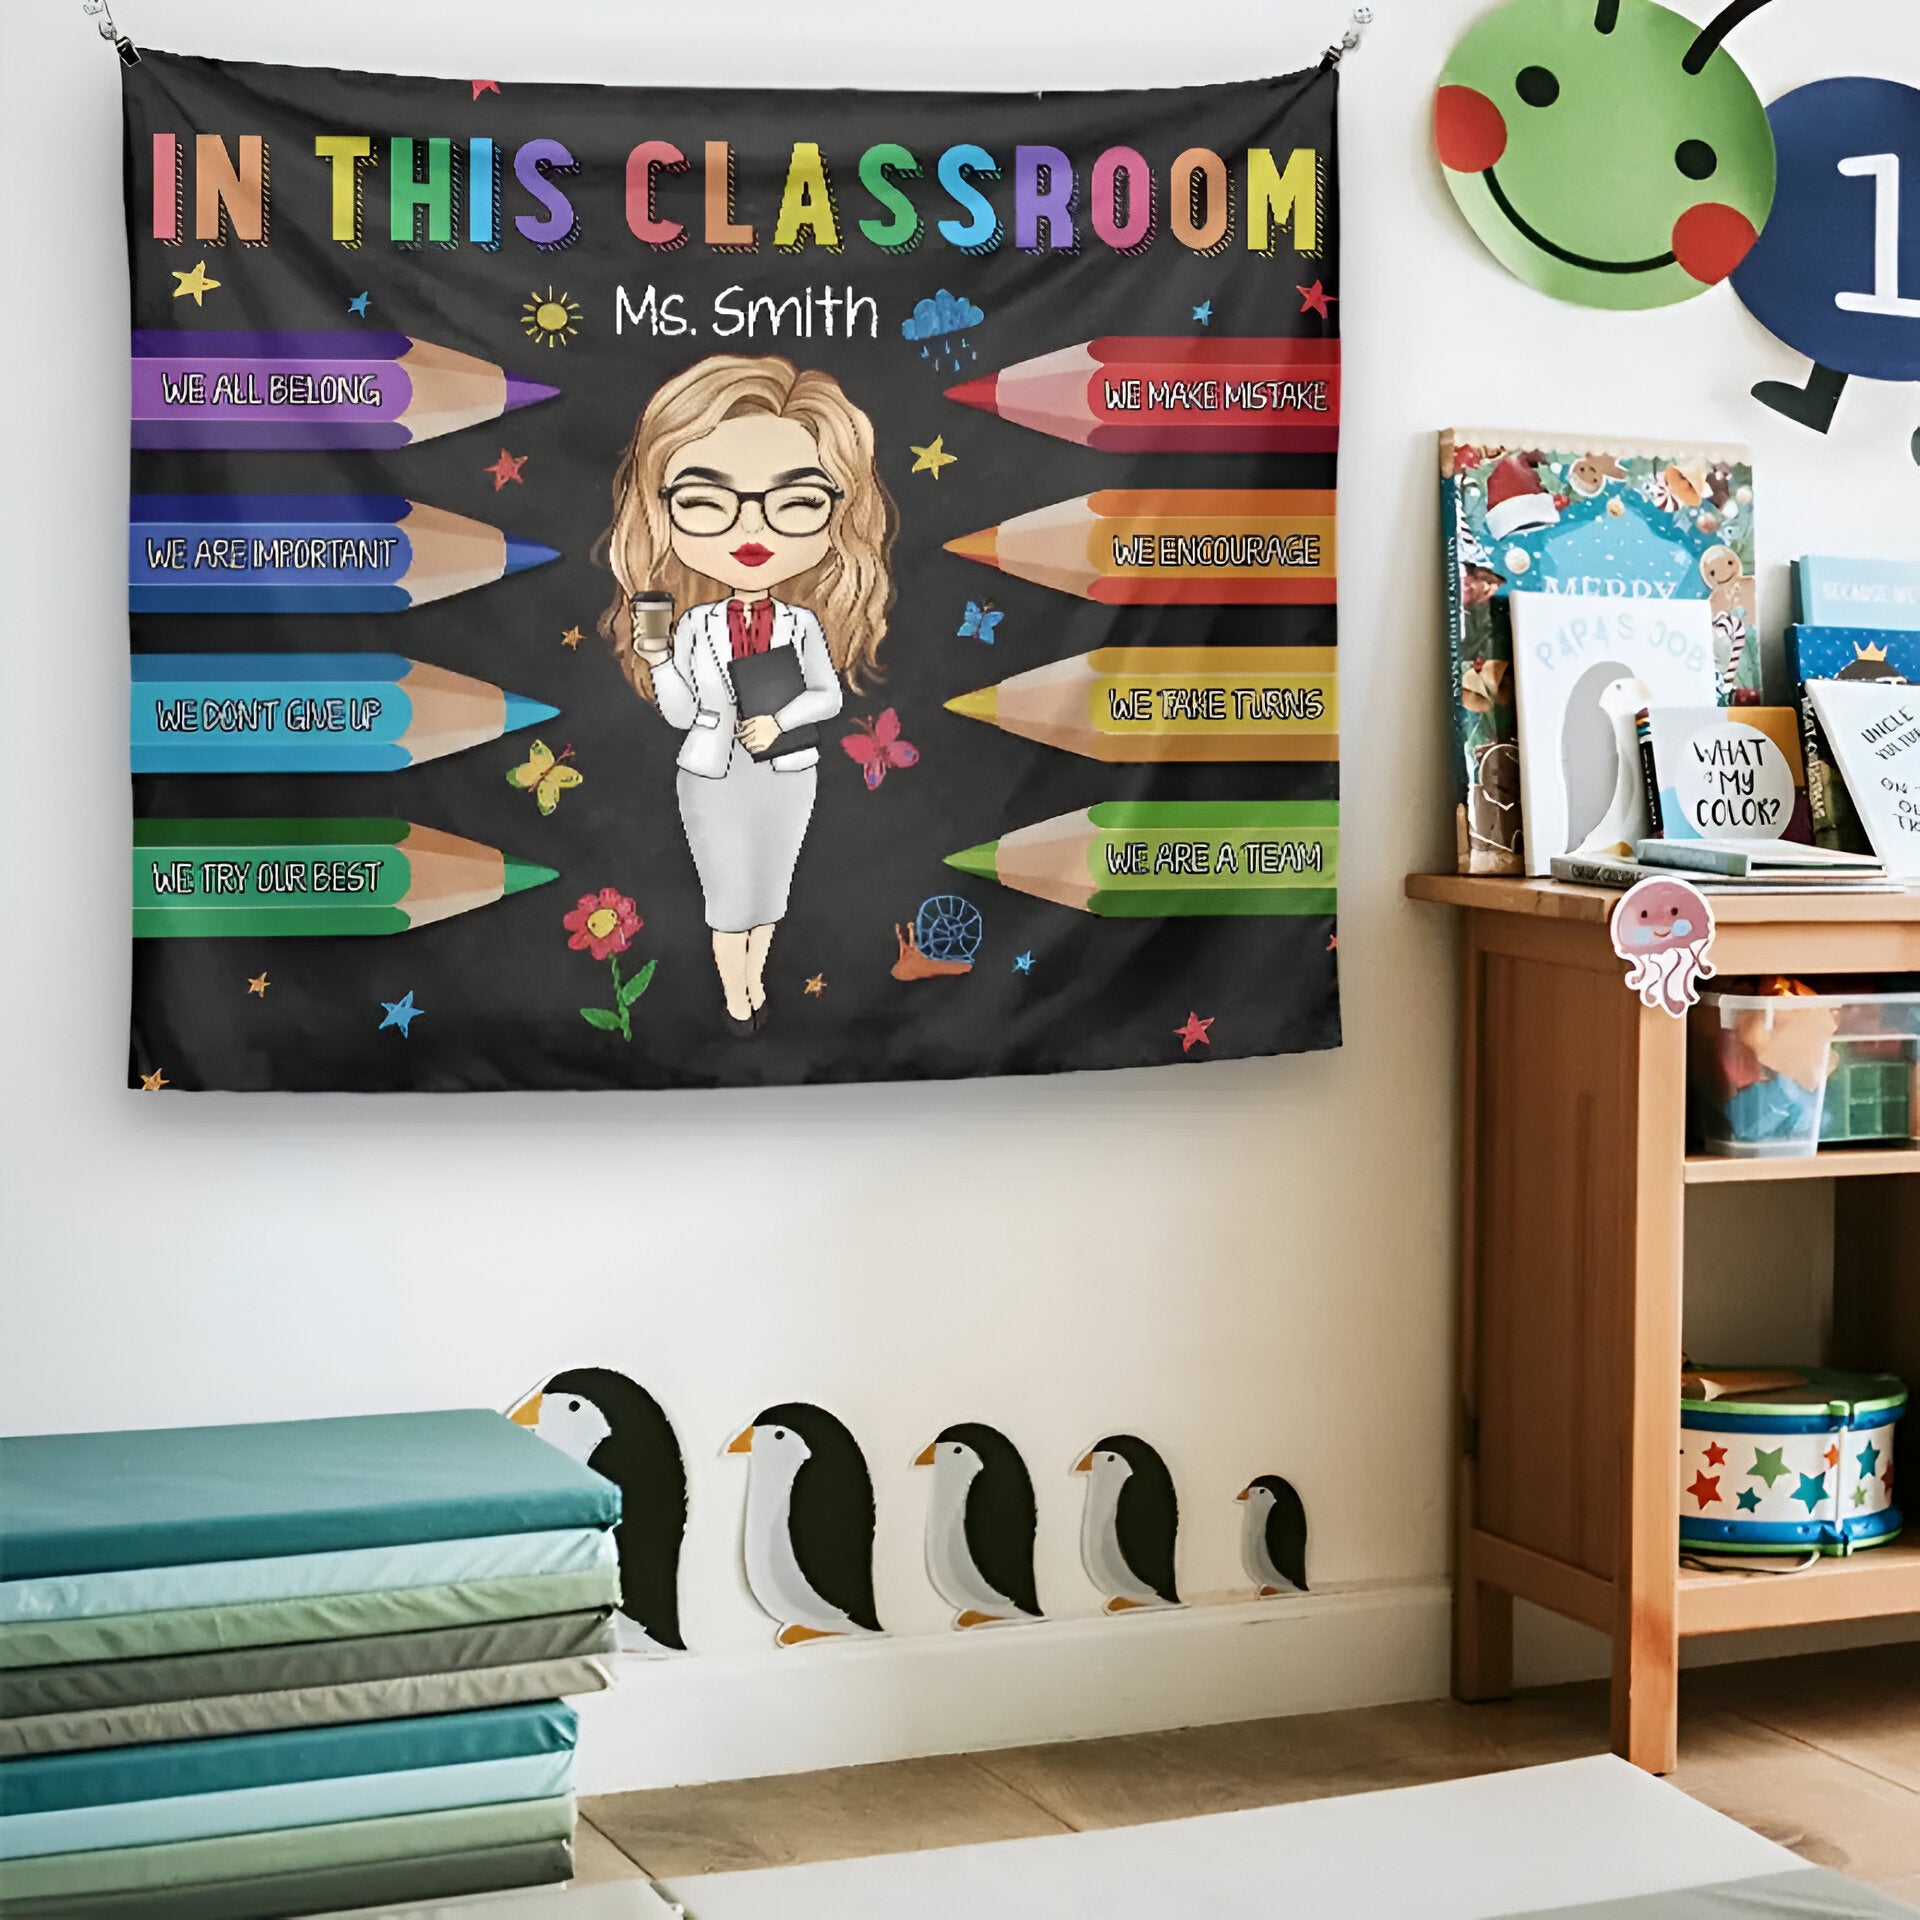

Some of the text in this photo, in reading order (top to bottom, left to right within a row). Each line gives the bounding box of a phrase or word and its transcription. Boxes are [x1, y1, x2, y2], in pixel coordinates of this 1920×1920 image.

[153, 133, 1323, 259] IN THIS CLASSROOM
[1835, 153, 1920, 318] 1
[615, 284, 878, 339] Ms. Smith
[161, 372, 382, 408] WE ALL BELONG
[1105, 379, 1329, 412] WE MAKE MISTAKE
[147, 538, 398, 570] WE ARE IMPORTANT
[1112, 535, 1320, 567] WE ENCOURAGE
[1648, 620, 1707, 672] JOB
[157, 698, 382, 732] WE DON'T GIVE UP
[1109, 688, 1324, 721] WE TAKE TURNS
[1861, 705, 1914, 745] UNCLE
[1693, 738, 1766, 766] WHAT
[1719, 769, 1755, 796] MY
[1696, 798, 1781, 827] COLOR?
[1106, 842, 1322, 875] WE ARE A TEAM
[152, 860, 382, 894] WE TRY OUR BEST
